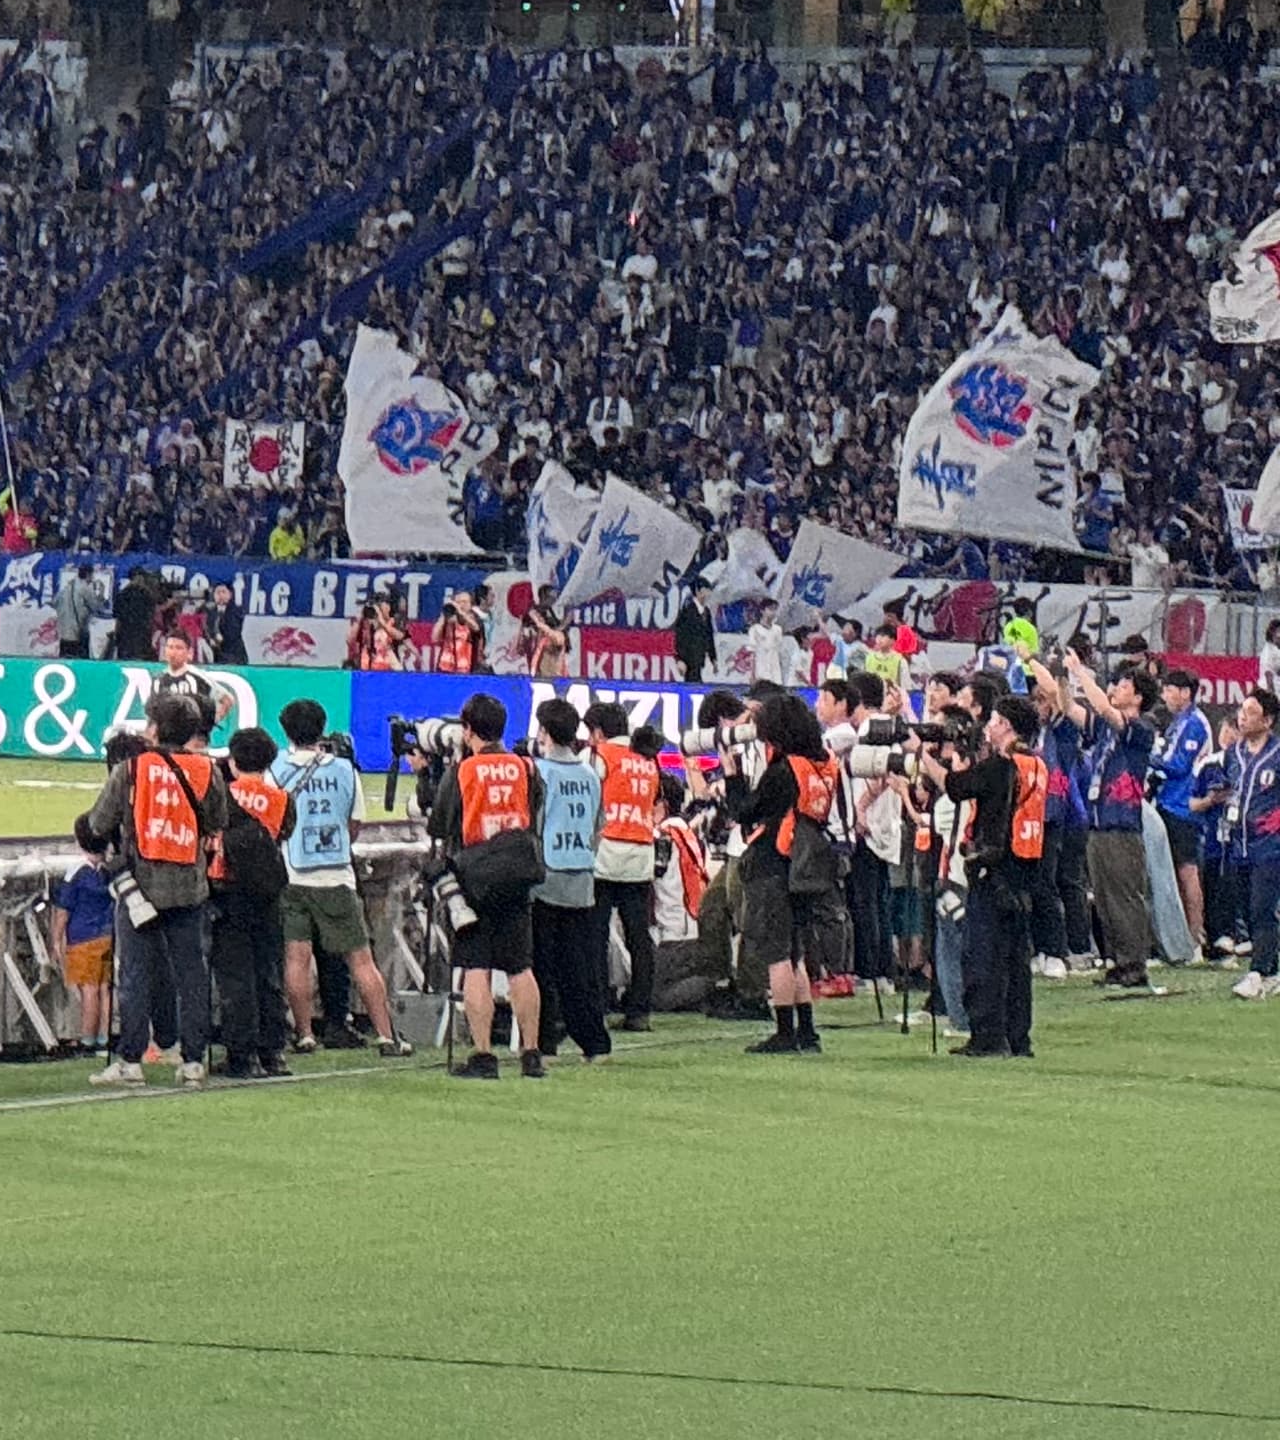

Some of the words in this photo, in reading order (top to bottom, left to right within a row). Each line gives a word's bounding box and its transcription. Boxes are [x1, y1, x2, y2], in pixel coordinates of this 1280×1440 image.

[310, 571, 429, 620] BEST
[587, 651, 685, 682] KIRIN
[476, 763, 520, 783] PHO
[621, 758, 657, 775] PHO
[308, 799, 331, 814] 22
[568, 803, 586, 819] 19
